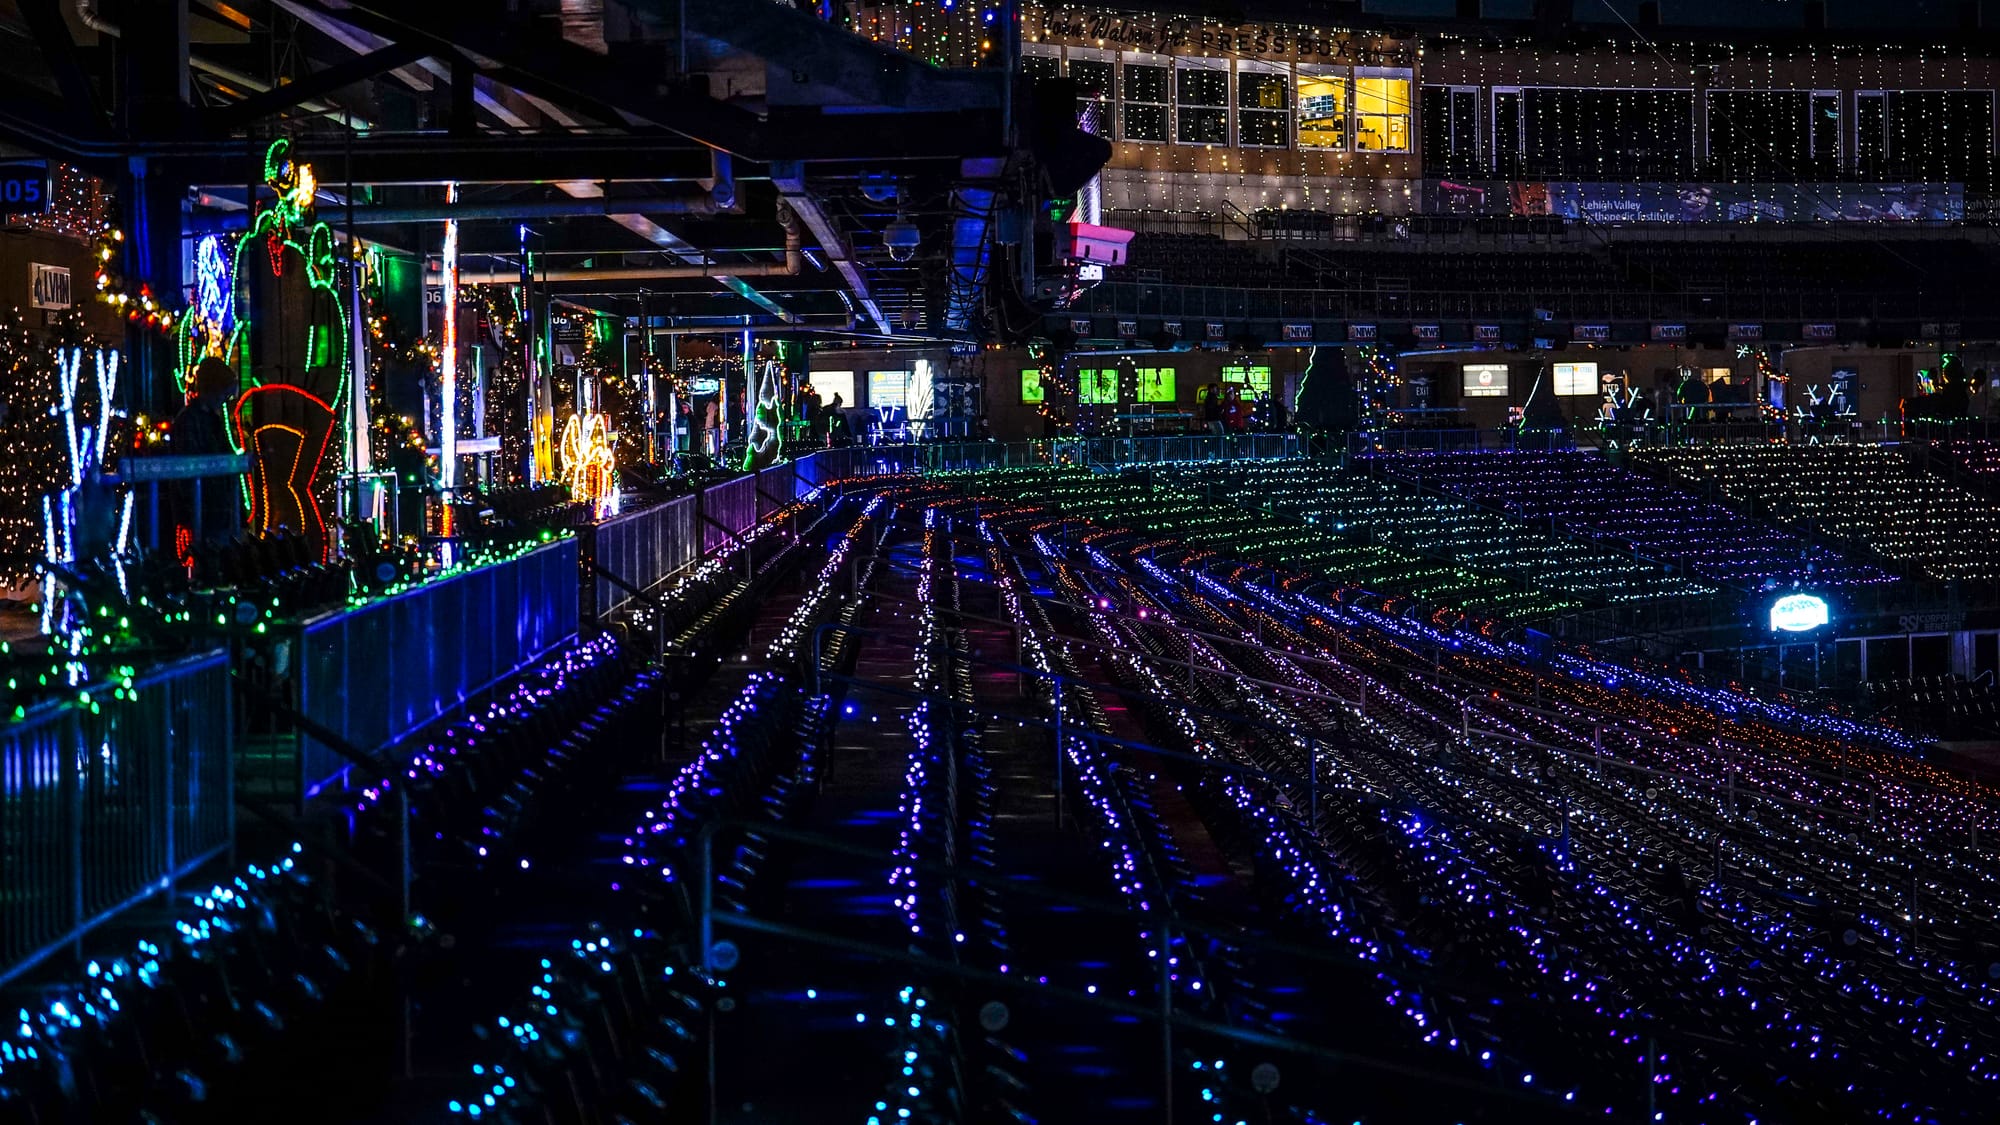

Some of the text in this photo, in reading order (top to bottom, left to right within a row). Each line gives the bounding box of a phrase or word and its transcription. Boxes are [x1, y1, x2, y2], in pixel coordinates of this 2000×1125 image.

[1201, 32, 1286, 54] PRESS
[1299, 37, 1349, 58] BOX
[1583, 199, 1642, 212] Lehigh Valley
[1290, 325, 1313, 338] NEWS
[1356, 325, 1377, 338] NEWS
[1419, 325, 1440, 338] NEWS
[1479, 326, 1500, 338] NEWS
[1583, 326, 1609, 338] NEWS
[1660, 325, 1686, 337] NEWS
[1738, 325, 1763, 337] NEWS
[1811, 325, 1836, 337] NEWS
[1415, 386, 1429, 397] EXIT
